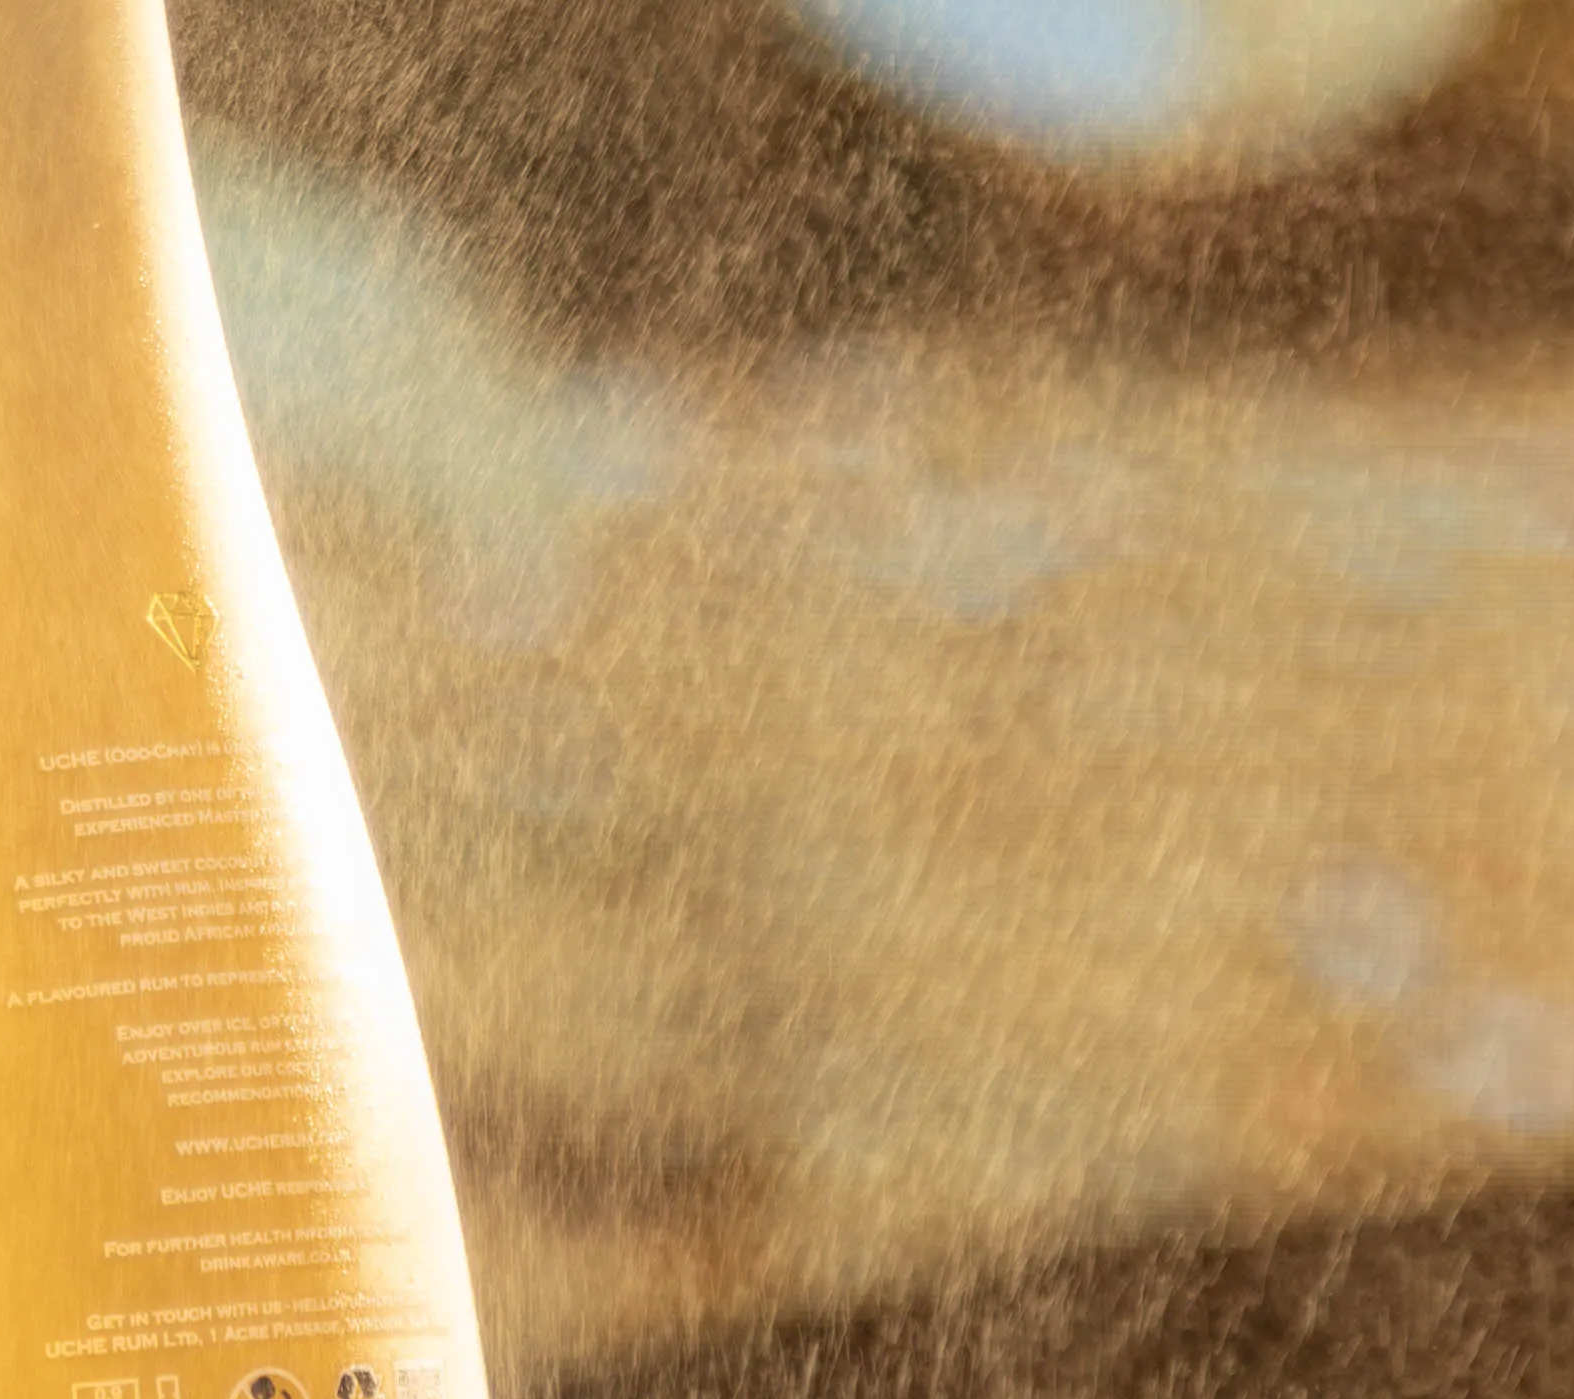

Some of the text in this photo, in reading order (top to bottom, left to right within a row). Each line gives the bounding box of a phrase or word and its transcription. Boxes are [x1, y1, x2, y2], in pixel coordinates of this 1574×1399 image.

[40, 750, 102, 771] UCHE
[60, 792, 150, 815] DISTILLED
[155, 790, 176, 805] BY
[180, 789, 212, 804] ONE
[74, 811, 194, 837] EXPERIENCED
[14, 875, 29, 891] A
[34, 869, 85, 888] SILKY
[90, 864, 129, 881] AND
[132, 858, 191, 877] SWEET
[19, 889, 122, 914] PERFECTLY
[126, 884, 171, 901] WITH
[58, 917, 82, 931] TO
[90, 912, 122, 928] THE
[128, 905, 178, 923] WEST
[182, 900, 235, 919] INDIES
[120, 929, 179, 948] PROUD
[185, 924, 252, 943] AFRICAN
[7, 991, 23, 1009] A
[26, 978, 136, 1006] FLAVOURED
[140, 974, 178, 992] RUM
[181, 972, 203, 989] TO
[116, 1023, 173, 1041] ENJOY
[178, 1018, 222, 1036] OVER
[122, 1041, 246, 1065] ADVENTUROUS
[162, 1065, 237, 1085] EXPLORE
[240, 1062, 273, 1078] OUR
[161, 1187, 217, 1205] ENJOY
[221, 1180, 274, 1199] UCHE
[104, 1240, 142, 1259] FOR
[147, 1232, 226, 1254] FURTHER
[230, 1229, 291, 1247] HEALTH
[86, 1312, 126, 1331] GET
[129, 1311, 149, 1328] IN
[153, 1305, 212, 1325] TOUCH
[216, 1301, 258, 1320] WITH
[262, 1300, 282, 1316] US
[45, 1338, 107, 1359] UCHE
[112, 1332, 158, 1354] RUM
[224, 1323, 269, 1343] ACRE
